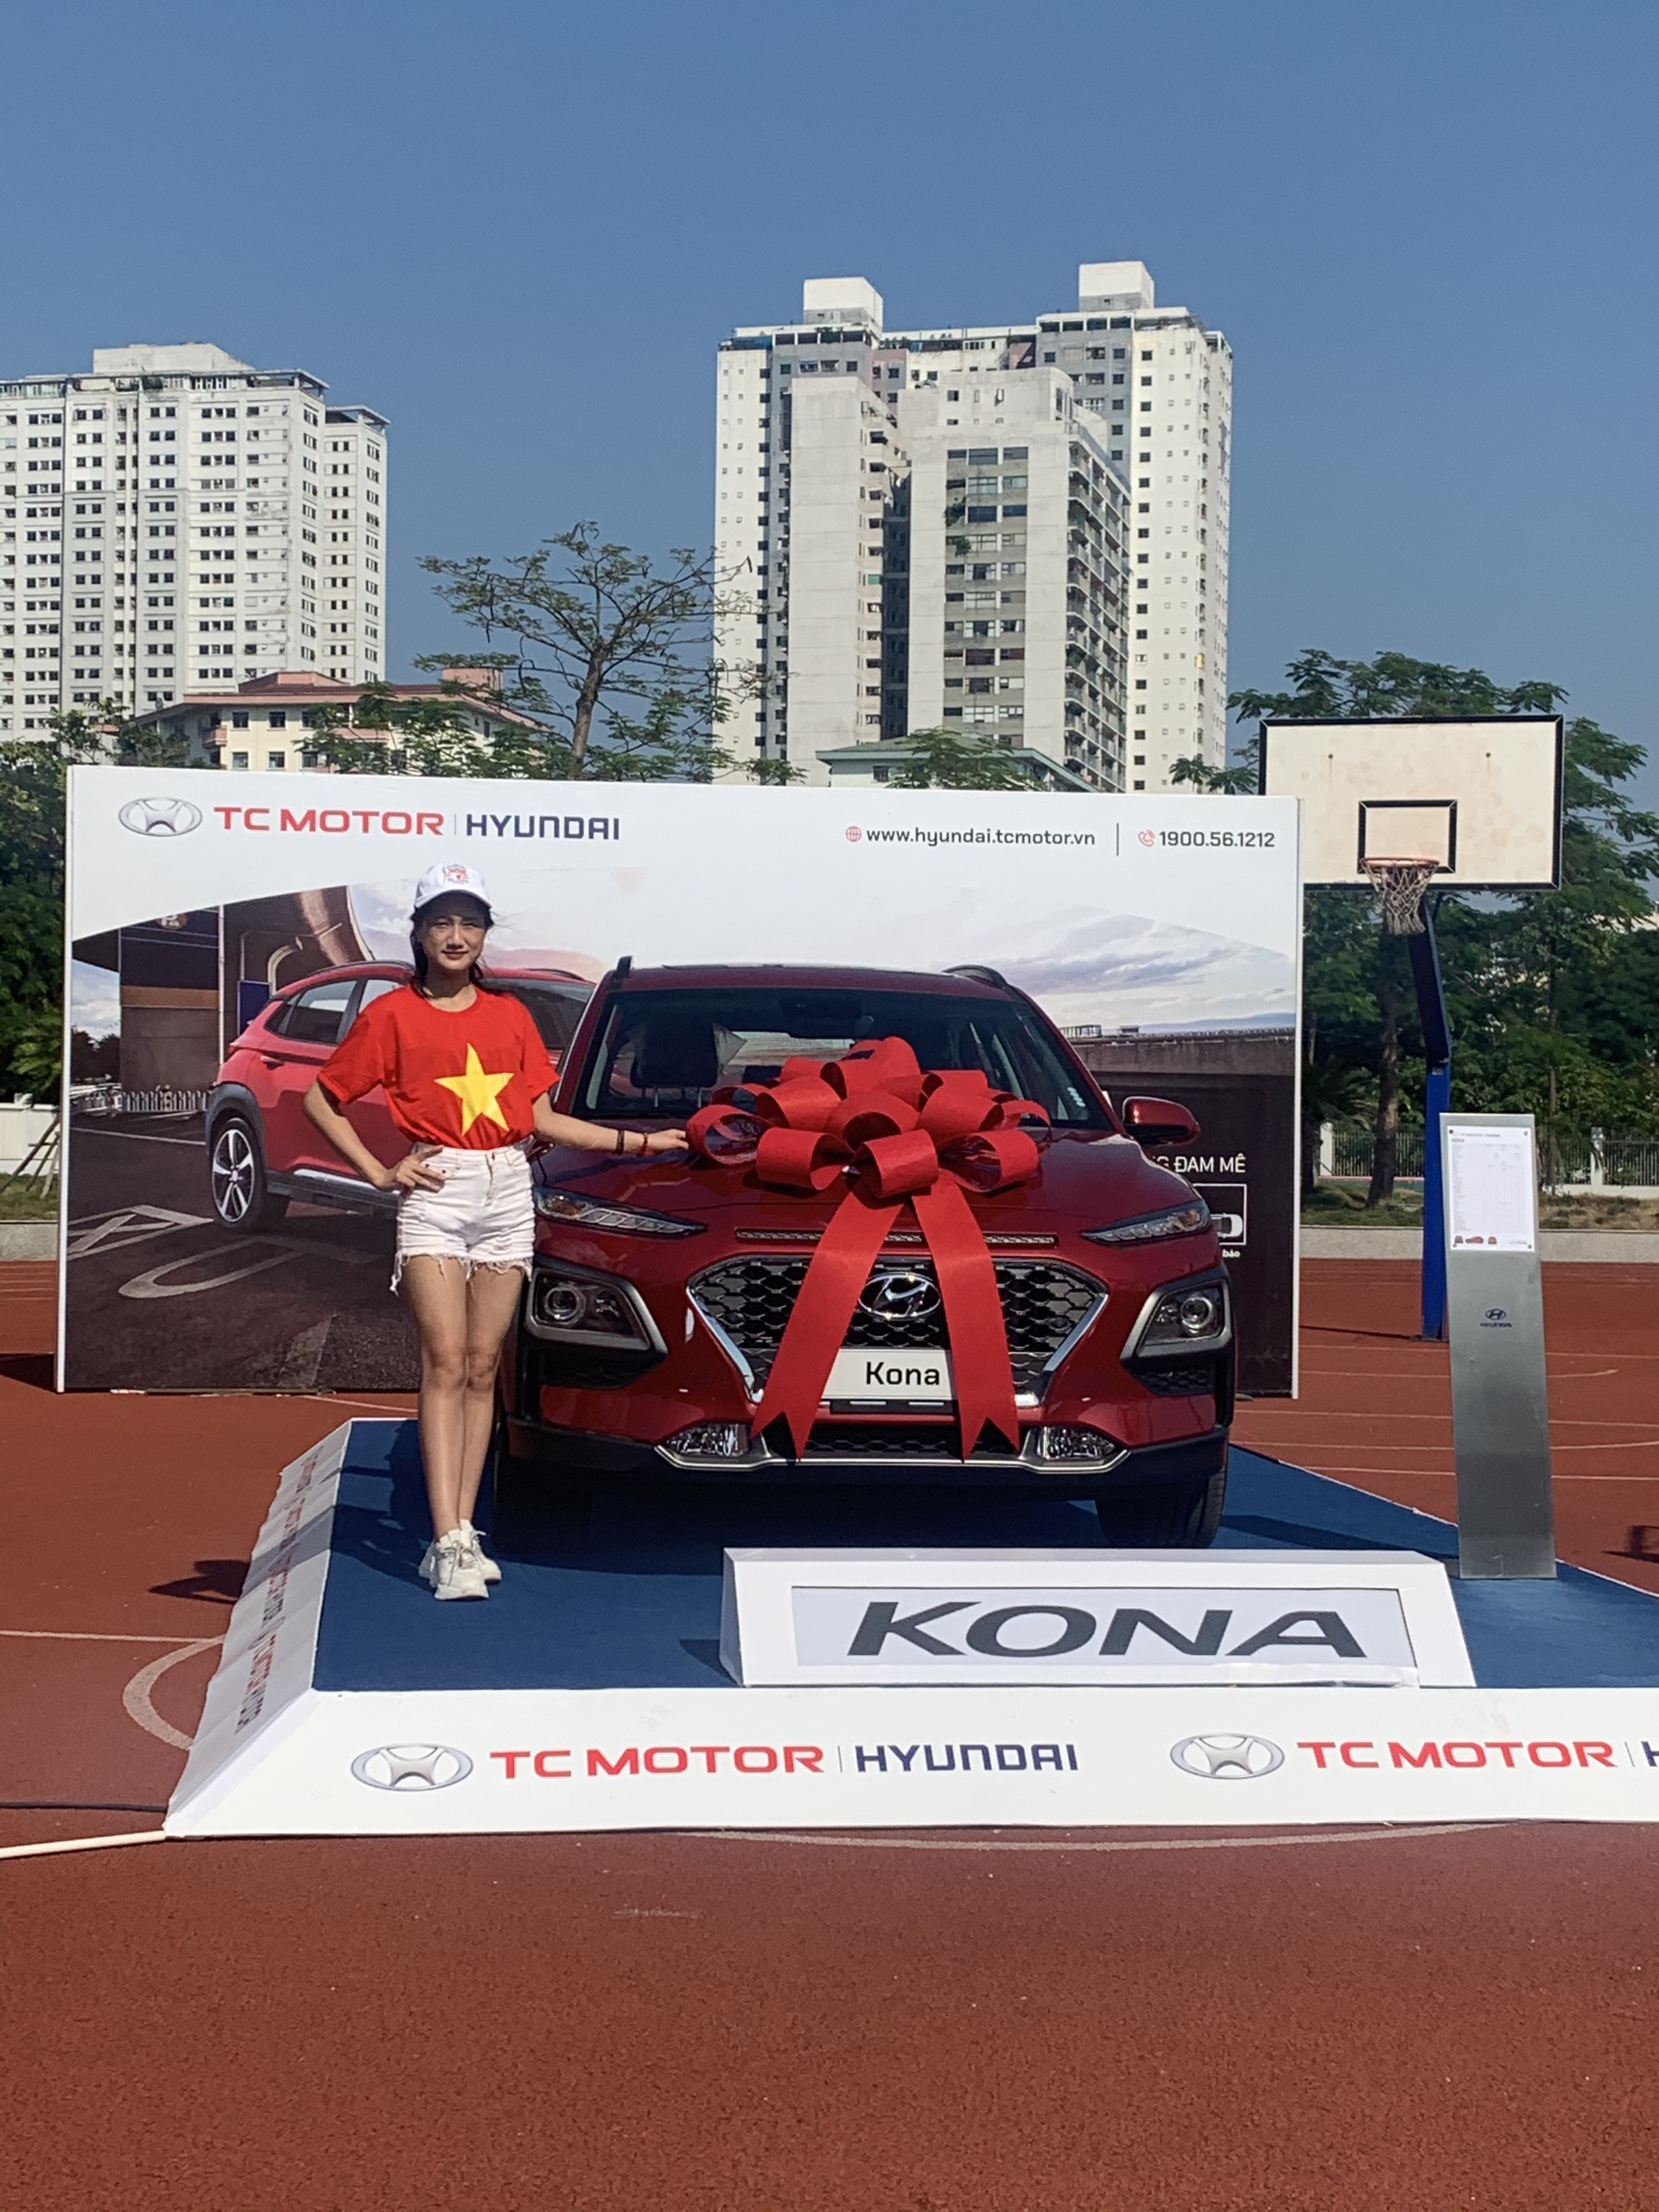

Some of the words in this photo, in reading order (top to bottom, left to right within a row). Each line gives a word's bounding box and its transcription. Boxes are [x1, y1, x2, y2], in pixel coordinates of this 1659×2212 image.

[214, 806, 270, 831] TC
[279, 808, 444, 836] MOTOR
[466, 814, 620, 841] HYUNDAI
[866, 827, 1096, 847] www.hyundai.tcmotor.vn
[1159, 831, 1275, 848] 1900.56.1212
[1173, 1155, 1214, 1173] ĐAM
[1219, 1152, 1246, 1173] MÊ
[866, 1361, 940, 1385] Kona
[847, 1601, 1368, 1658] KONA
[489, 1750, 572, 1780] TC
[587, 1745, 825, 1777] MOTOR
[855, 1744, 1079, 1772] HYUNDAI
[1296, 1741, 1380, 1769] TC
[1388, 1740, 1618, 1768] MOTOR
